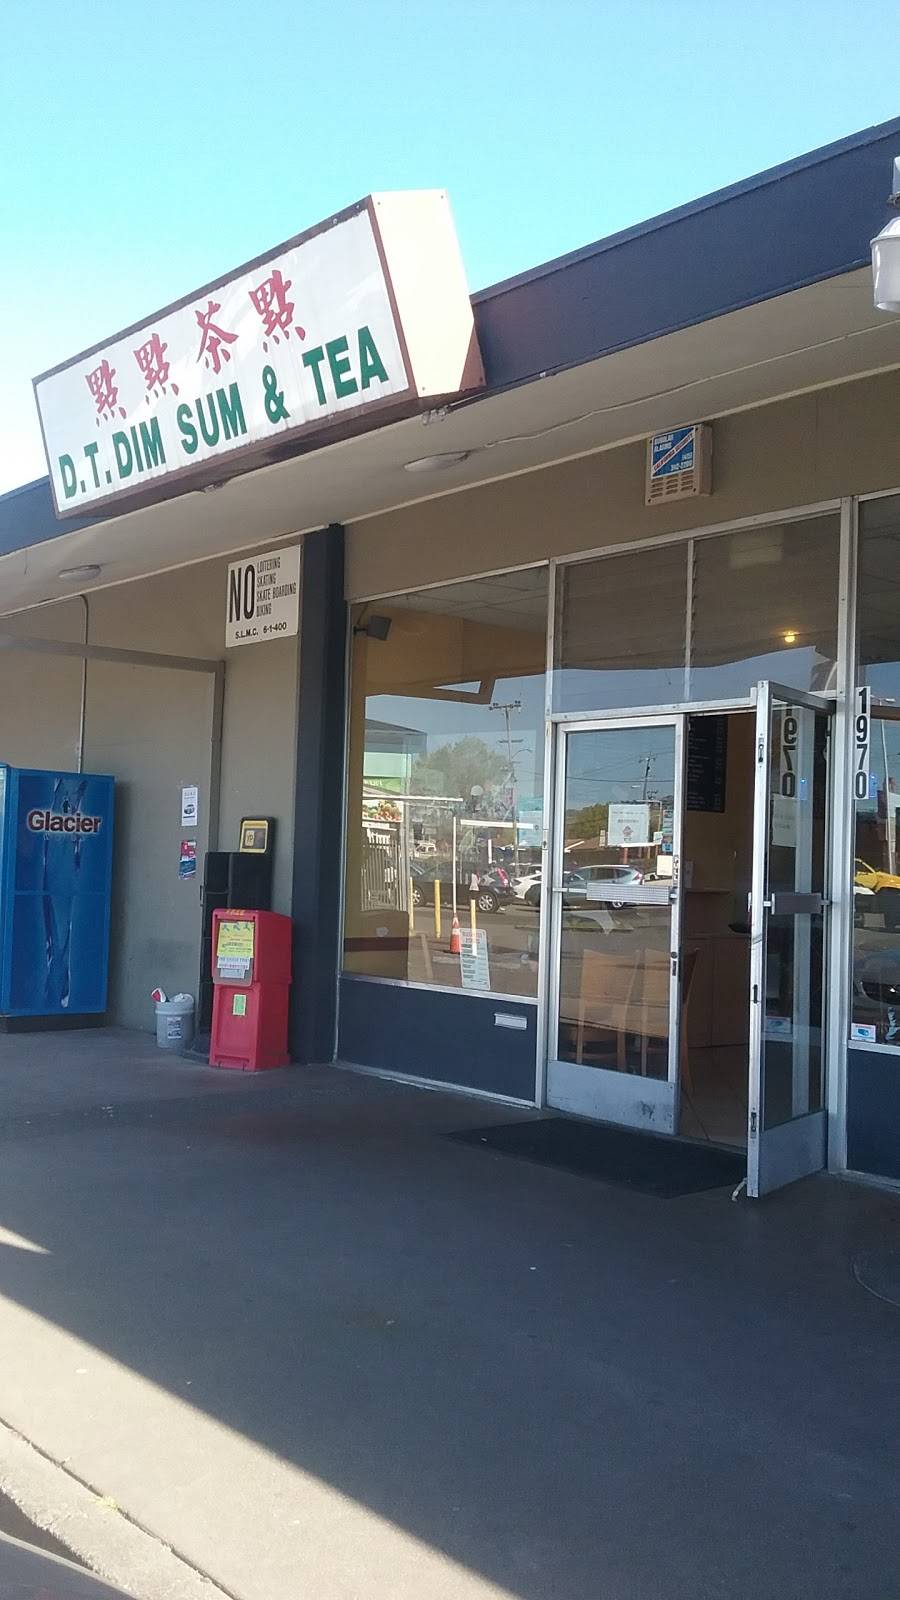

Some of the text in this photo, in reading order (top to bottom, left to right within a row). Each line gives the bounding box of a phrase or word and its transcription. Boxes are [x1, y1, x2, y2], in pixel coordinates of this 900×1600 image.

[176, 382, 248, 455] SUM
[262, 365, 291, 424] &
[301, 325, 389, 406] TEA
[256, 557, 281, 573] LOITERING
[256, 573, 277, 588] SKATING
[256, 582, 297, 602] SKATE BOARDING
[229, 564, 255, 623] NO
[855, 687, 868, 799] 1970
[27, 810, 102, 833] Glacier
